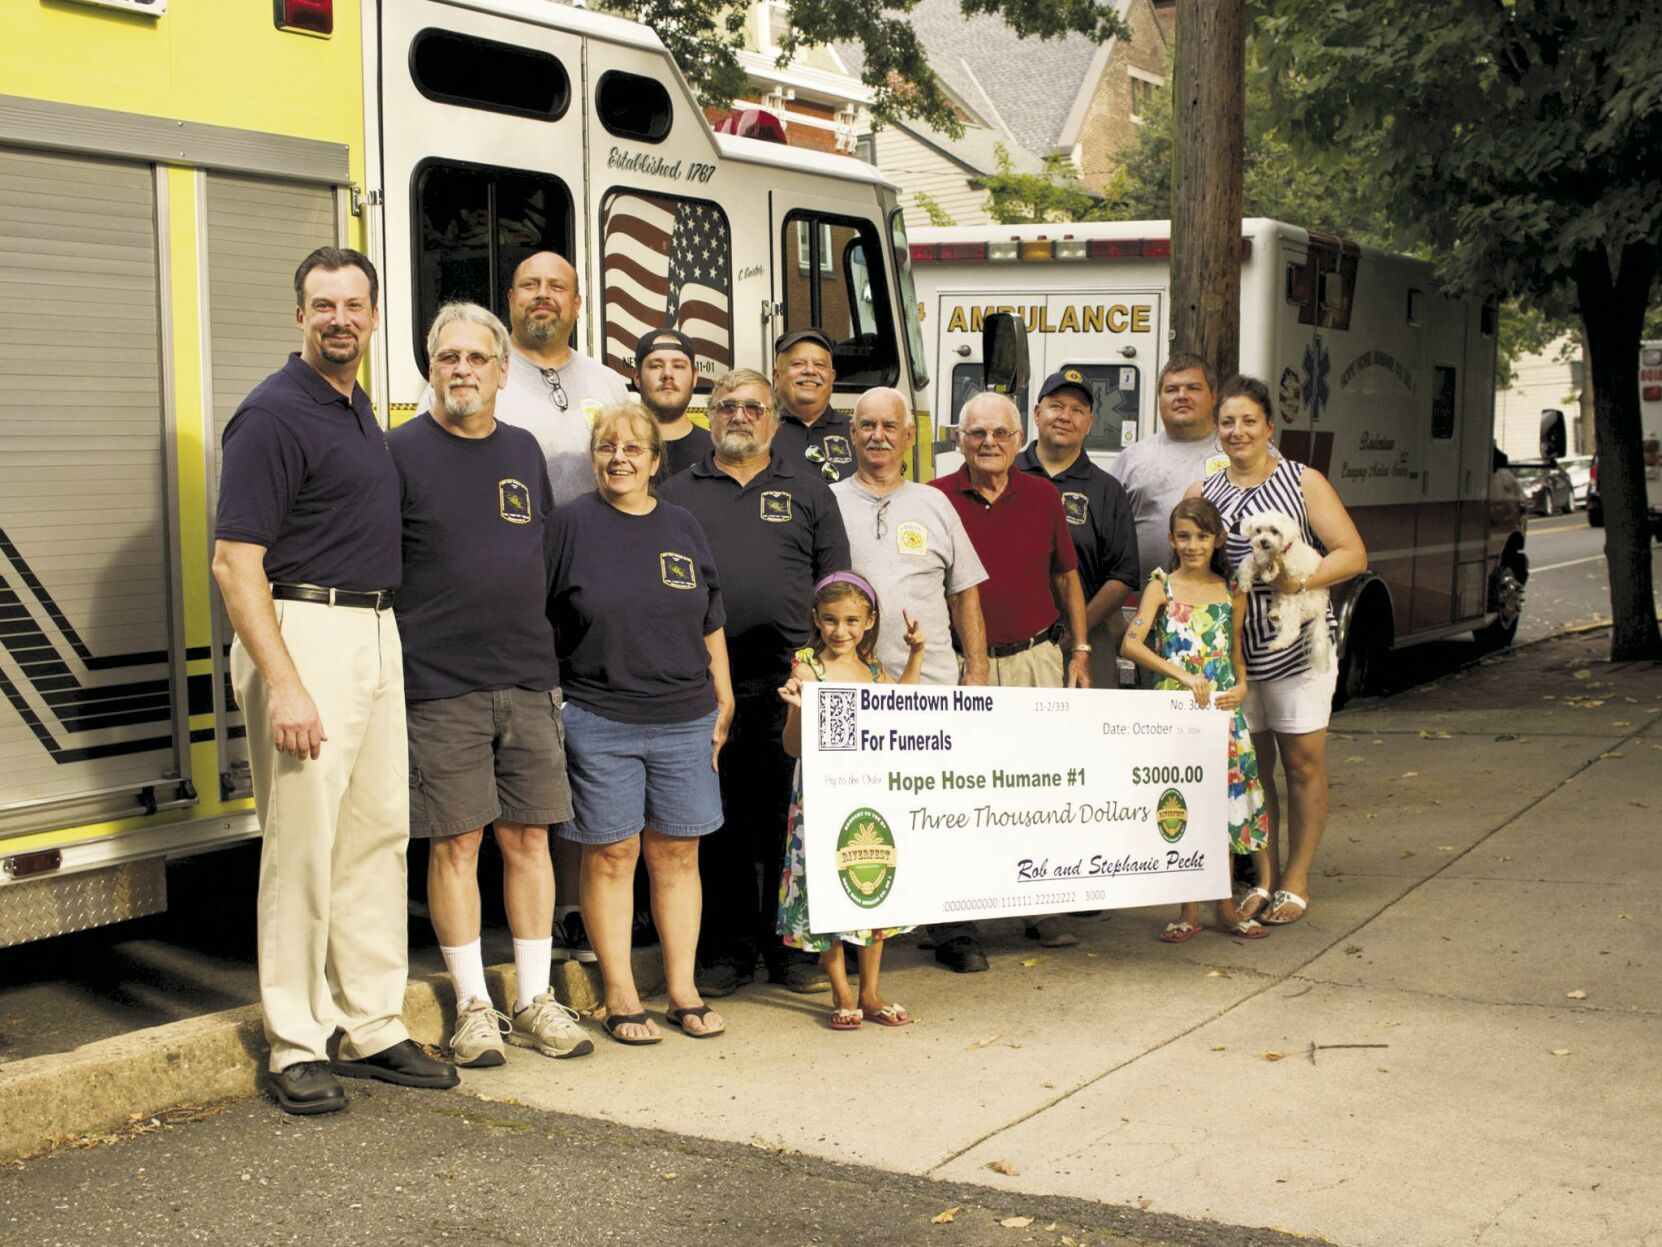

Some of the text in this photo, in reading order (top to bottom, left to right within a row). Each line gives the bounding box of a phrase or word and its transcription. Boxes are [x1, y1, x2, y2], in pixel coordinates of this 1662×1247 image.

[608, 146, 717, 184] Established 1767
[861, 689, 993, 711] Bordentown Home
[1035, 701, 1070, 713] 11-2/333
[1170, 699, 1186, 711] No.
[1102, 722, 1131, 735] Date:
[1132, 722, 1173, 735] October
[861, 729, 952, 751] For Funerals
[888, 767, 1086, 795] Hope Hose Humane #1
[1132, 765, 1204, 785] $3000.00
[909, 807, 970, 830] Three
[974, 802, 1077, 828] Thousand
[1079, 801, 1151, 824] Dollars
[842, 849, 891, 863] RIVERFEST
[1017, 850, 1205, 880] Rob and Stephanie Pecht
[1086, 889, 1106, 901] 3000
